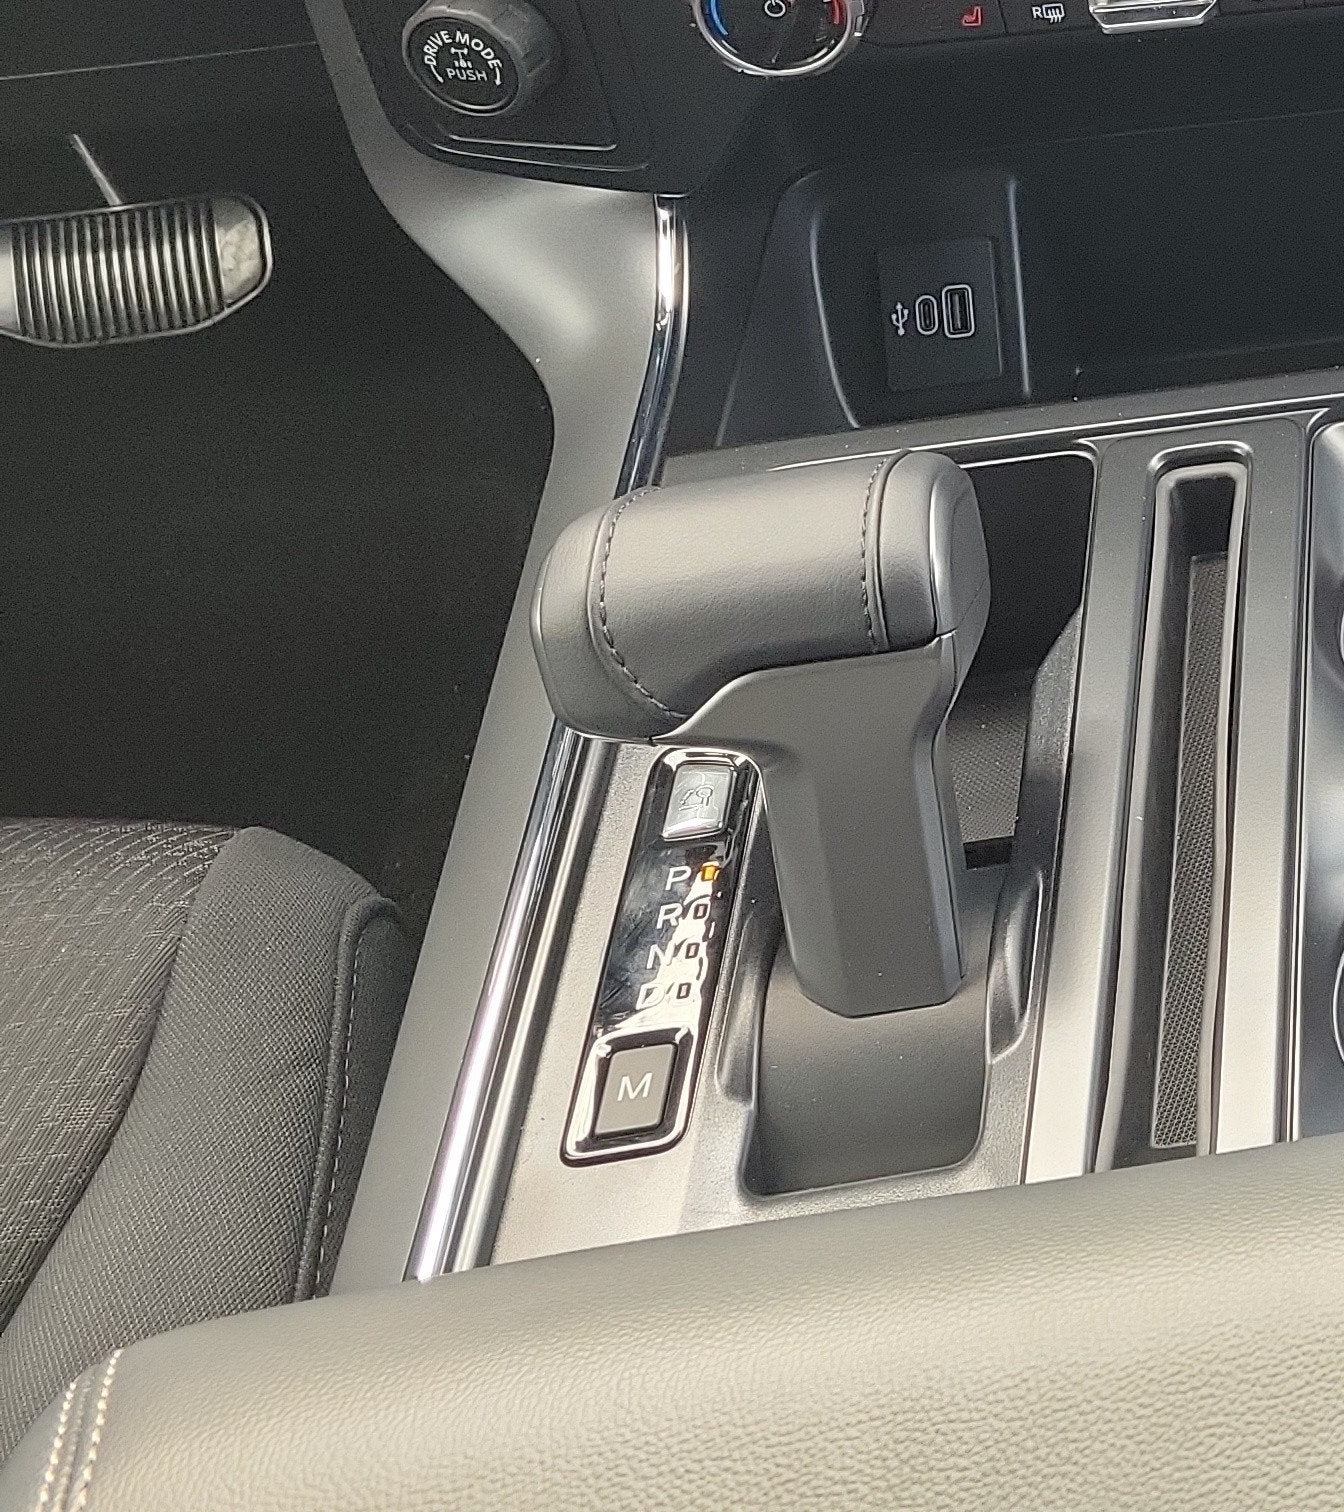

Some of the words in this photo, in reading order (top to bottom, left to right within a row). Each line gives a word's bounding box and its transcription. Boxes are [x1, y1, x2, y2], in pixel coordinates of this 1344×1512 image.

[422, 30, 452, 67] DRIVE
[456, 30, 502, 70] MODE
[446, 68, 488, 82] PUSH
[664, 864, 692, 891] P
[656, 902, 682, 930] R
[646, 940, 675, 970] N
[636, 981, 666, 1009] D
[616, 1072, 653, 1102] M
